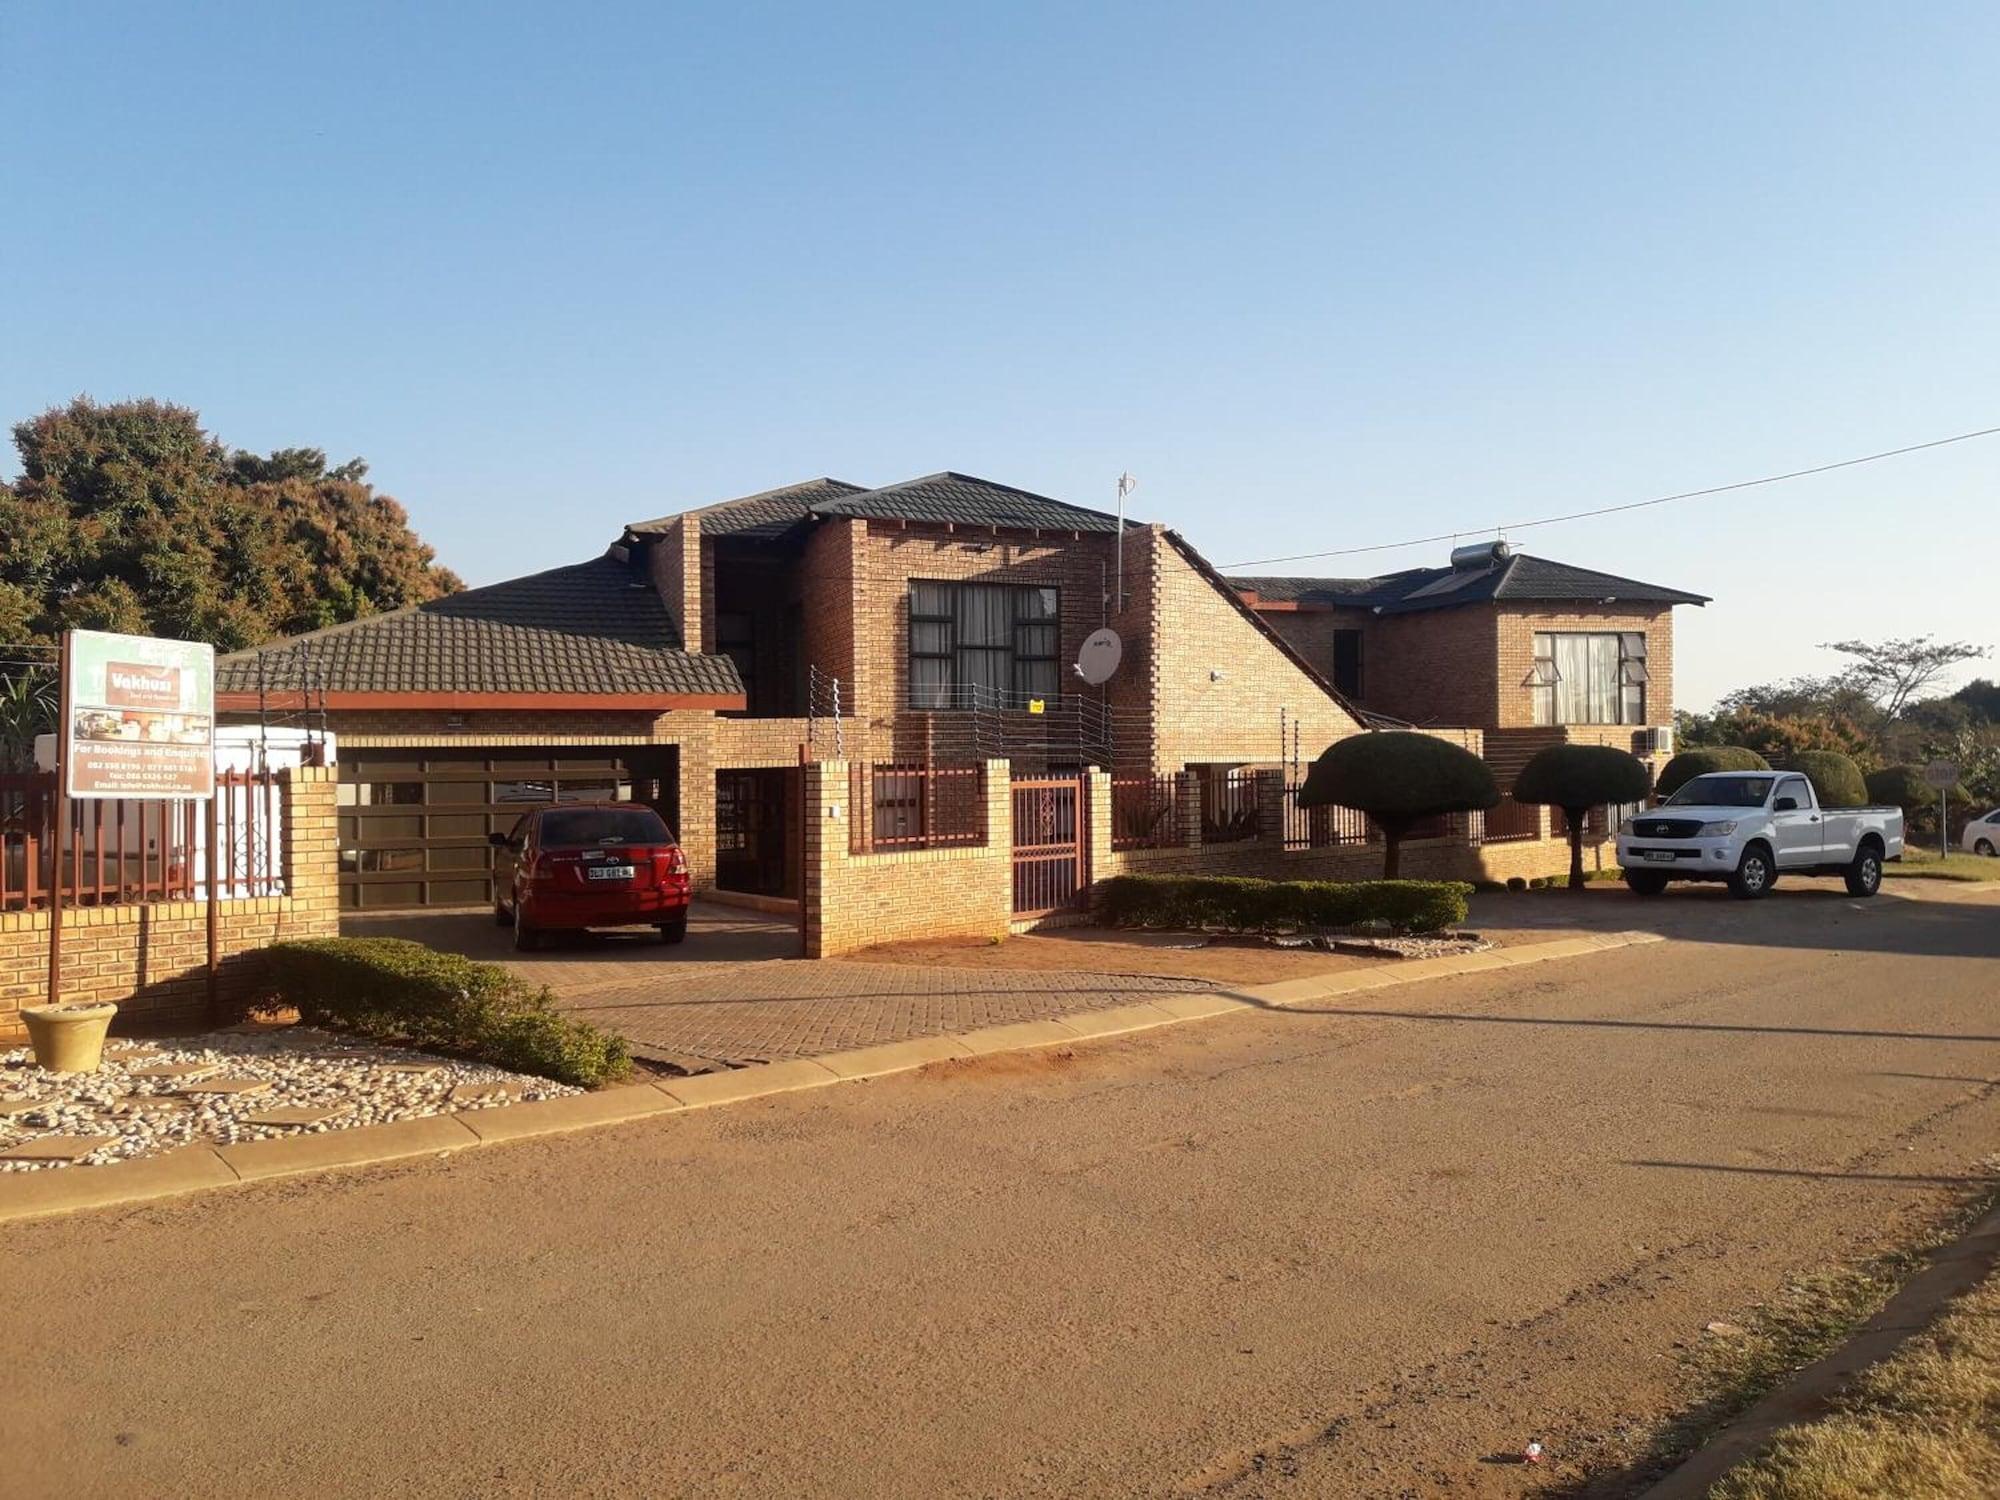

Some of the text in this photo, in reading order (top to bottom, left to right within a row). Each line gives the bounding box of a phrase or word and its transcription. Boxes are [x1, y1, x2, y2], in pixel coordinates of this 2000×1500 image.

[112, 672, 172, 692] Vakhusi
[74, 743, 92, 754] For
[94, 744, 142, 758] Bookings
[144, 747, 163, 756] and
